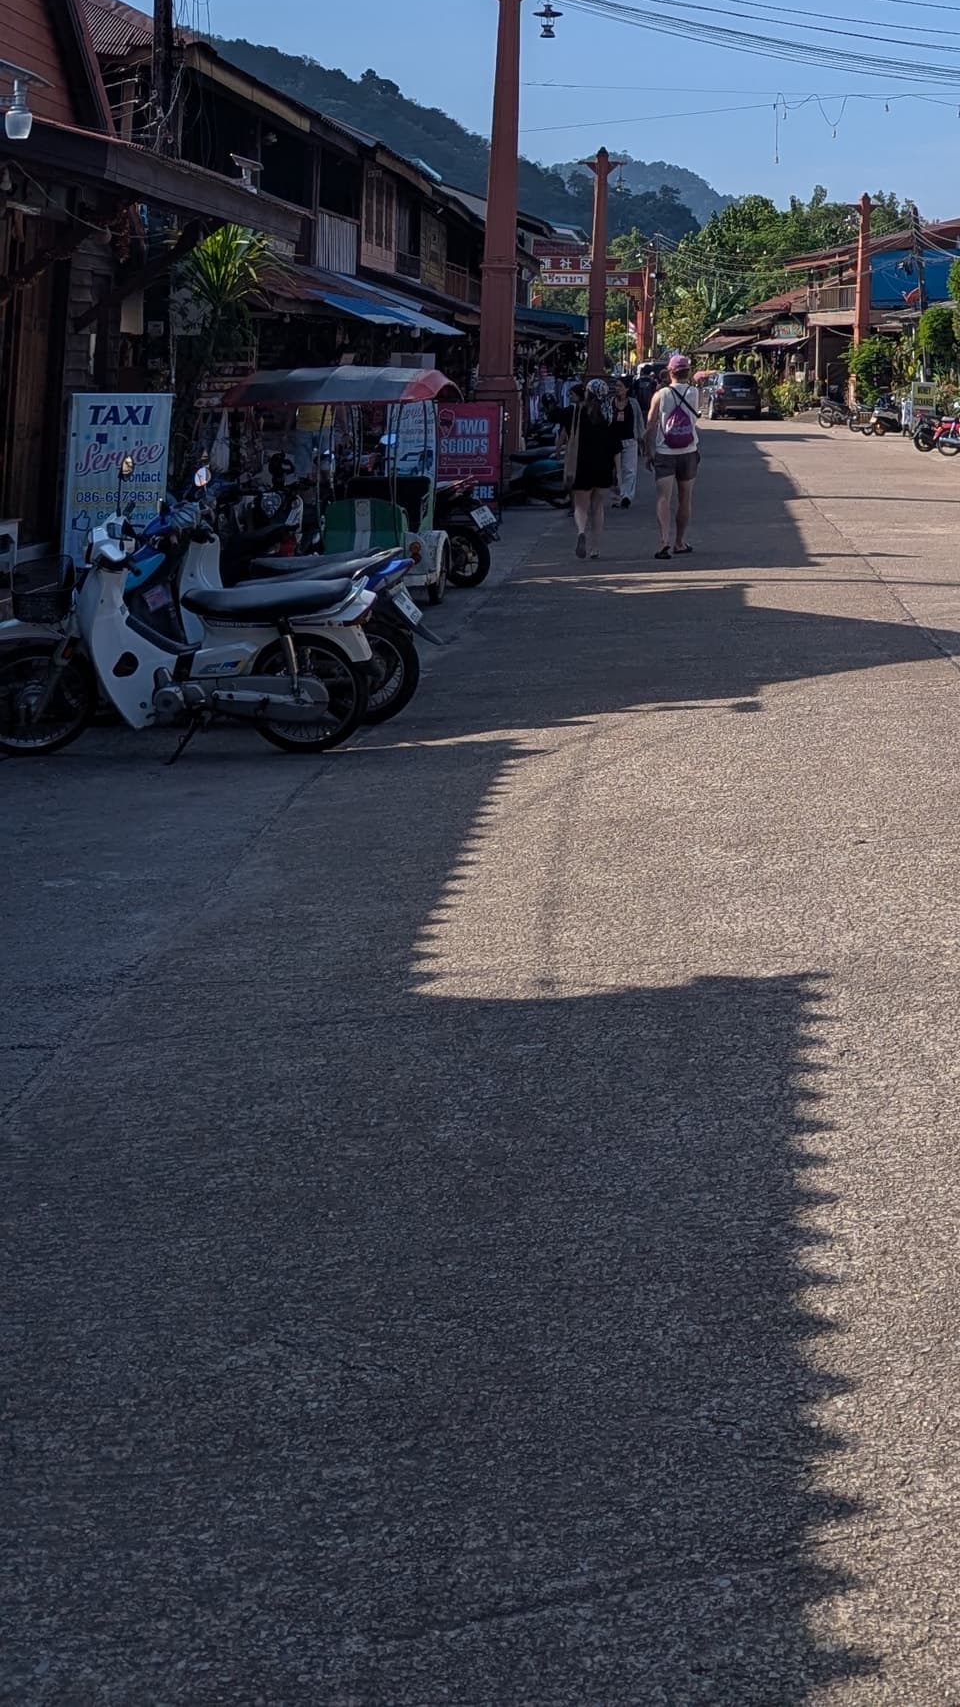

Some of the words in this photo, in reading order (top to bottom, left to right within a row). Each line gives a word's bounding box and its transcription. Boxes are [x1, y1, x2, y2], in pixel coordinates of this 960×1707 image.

[88, 405, 153, 426] TAXI
[455, 418, 489, 435] TWO
[440, 437, 489, 455] SCOOPS
[471, 485, 495, 500] ERE
